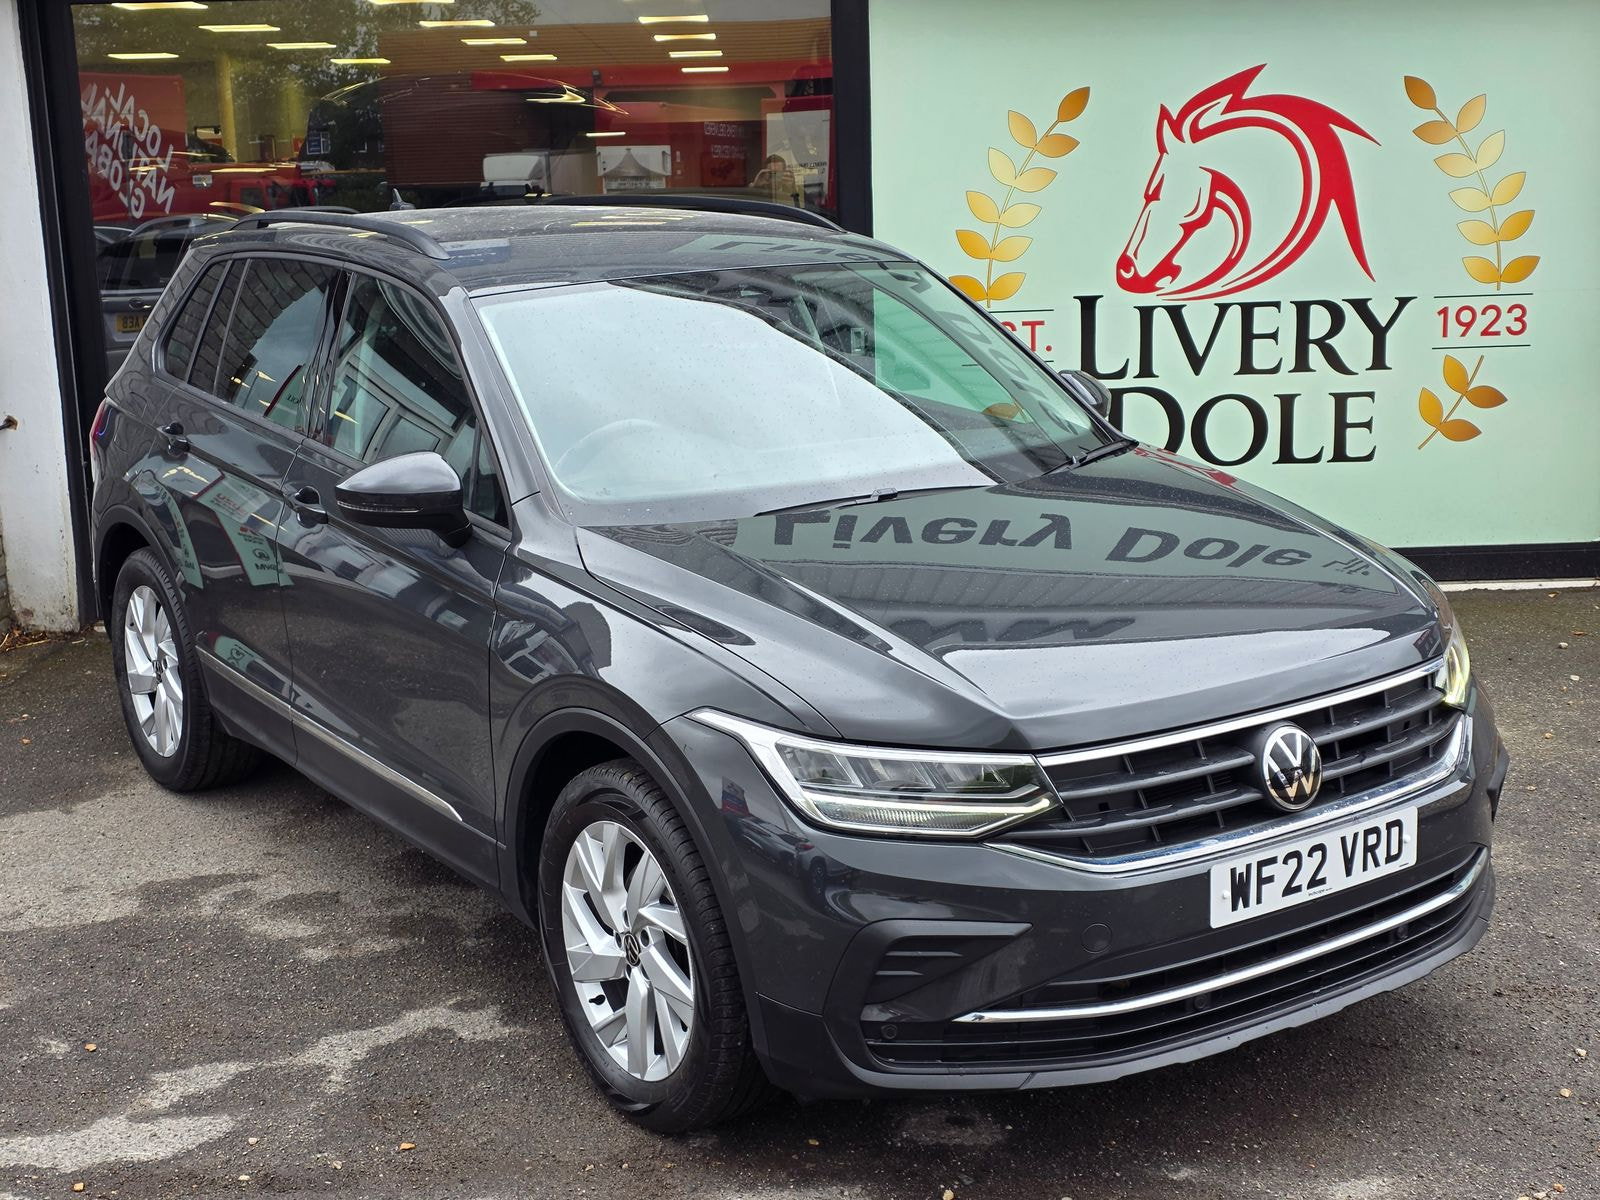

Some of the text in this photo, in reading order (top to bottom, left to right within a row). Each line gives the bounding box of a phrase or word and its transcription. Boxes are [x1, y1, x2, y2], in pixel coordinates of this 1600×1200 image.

[1073, 295, 1418, 380] LIVERY
[1436, 303, 1528, 338] 1923
[1107, 386, 1377, 466] DOLE
[1230, 818, 1404, 912] WF22 VRD
